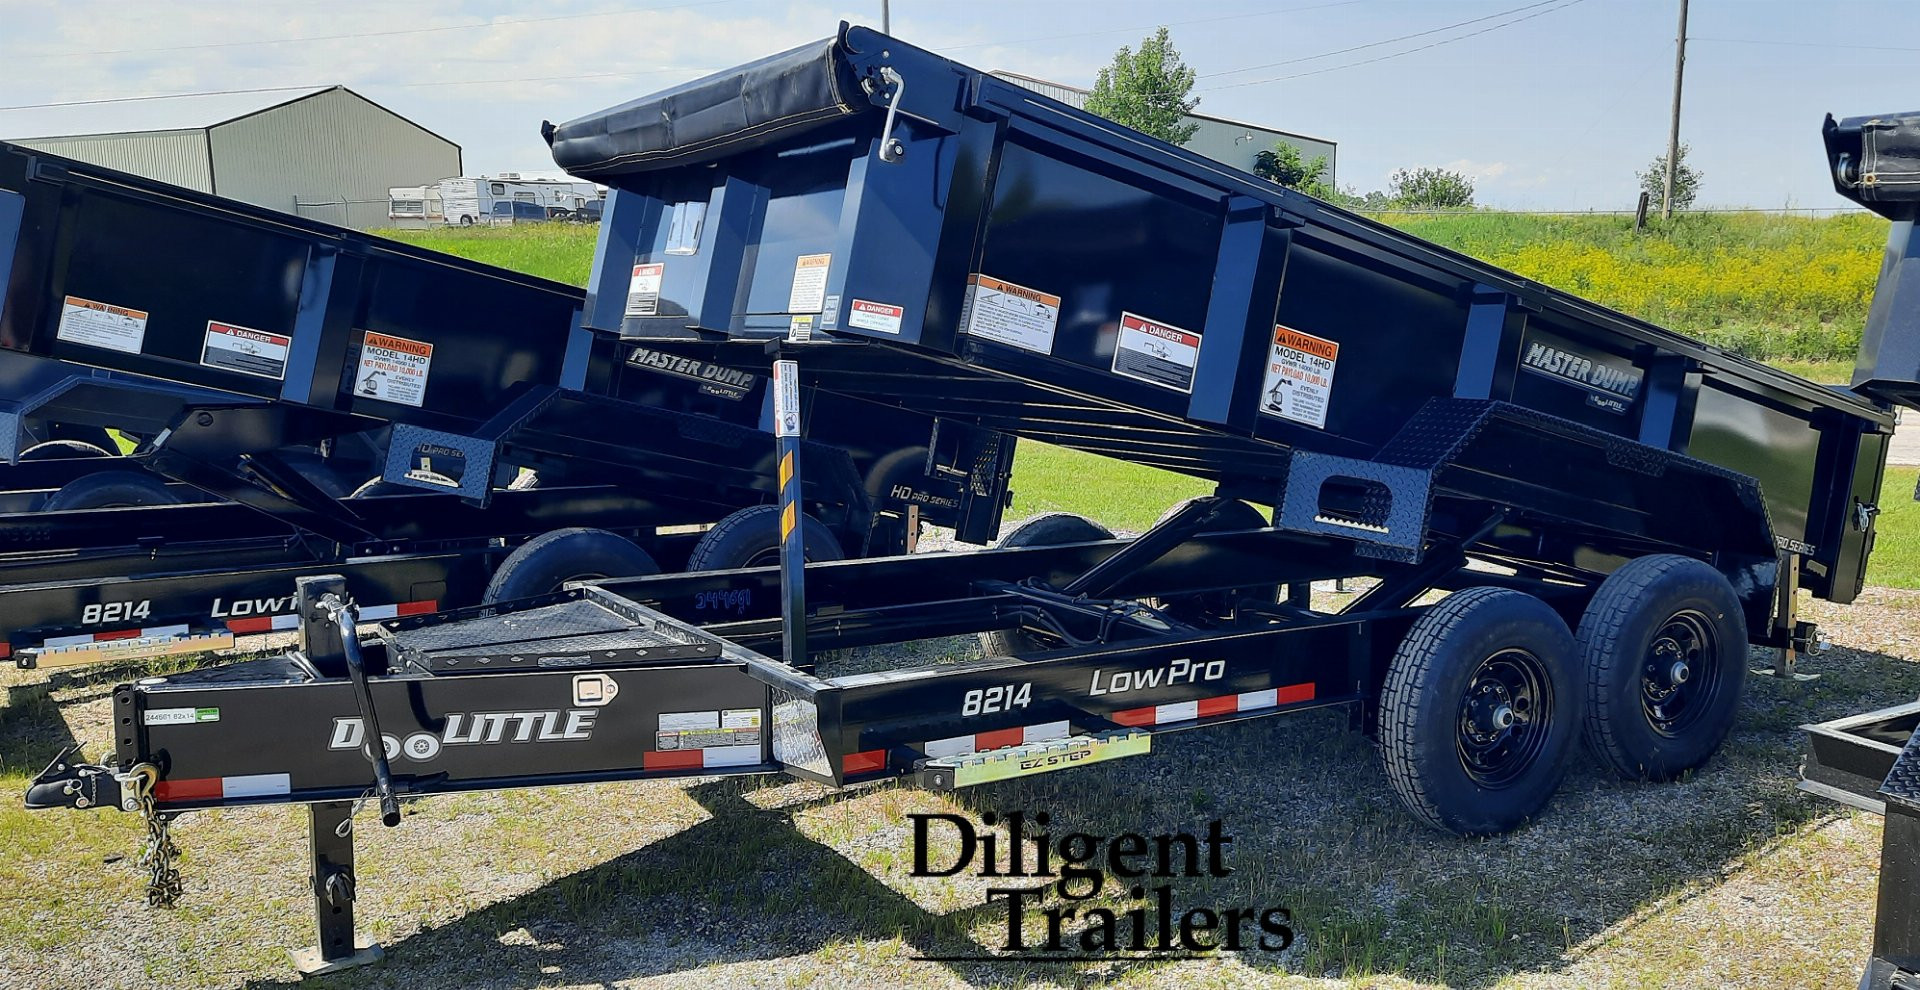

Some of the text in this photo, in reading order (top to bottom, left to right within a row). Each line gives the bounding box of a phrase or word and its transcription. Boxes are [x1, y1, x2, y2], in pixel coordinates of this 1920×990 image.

[1006, 284, 1041, 301] WARNING
[866, 304, 894, 315] DANGER
[236, 329, 272, 343] DANGER
[1148, 324, 1183, 342] DANGER
[378, 337, 427, 354] WARNING
[1287, 333, 1332, 357] WARNING
[366, 347, 426, 365] MODEL 14HD
[1274, 346, 1331, 370] MODEL 14HD
[375, 361, 398, 372] PAYLOAD
[629, 347, 754, 387] MASTER DUMP
[1281, 366, 1304, 380] PAYLOAD
[1524, 342, 1639, 396] MASTER DUMP
[1291, 390, 1325, 403] DISTRIBUTED
[432, 447, 449, 456] PRO
[890, 484, 959, 508] HD PRO SERIES
[1789, 540, 1816, 556] SERIES
[82, 600, 150, 624] 8214
[961, 682, 1032, 717] 8214
[1020, 750, 1092, 770] EZ STEP
